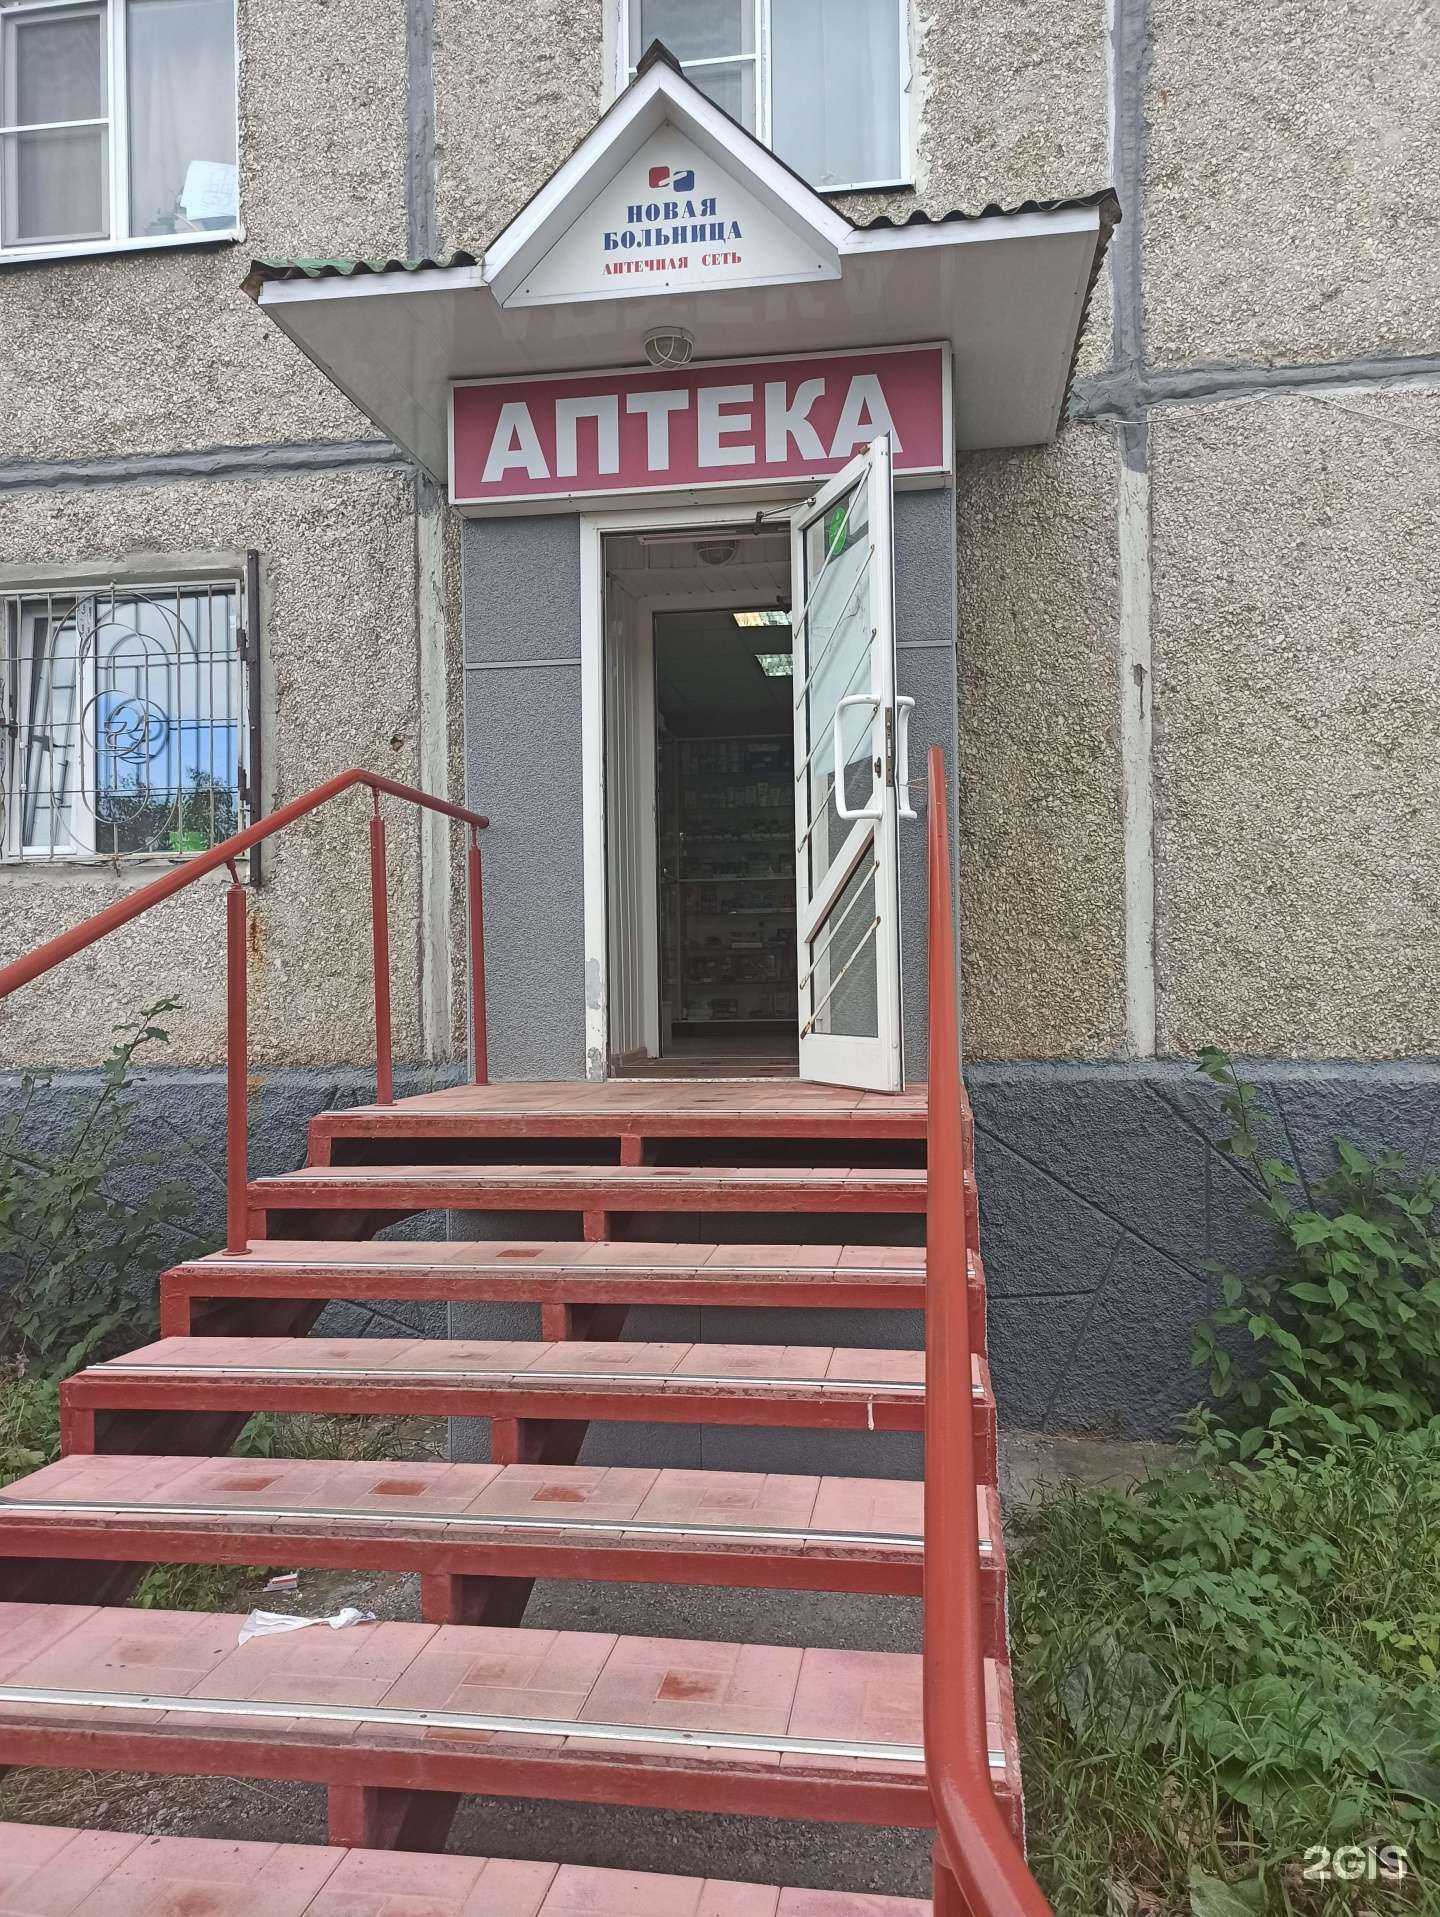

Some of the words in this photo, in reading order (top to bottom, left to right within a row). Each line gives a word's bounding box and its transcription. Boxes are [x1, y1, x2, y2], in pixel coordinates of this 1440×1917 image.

[627, 198, 717, 223] НОВАЯ
[603, 221, 743, 250] БОЛЬНИЦА
[602, 256, 689, 275] АПТЕЧНАЯ
[701, 252, 742, 266] СЕТЬ
[481, 374, 904, 483] АПТЕКА
